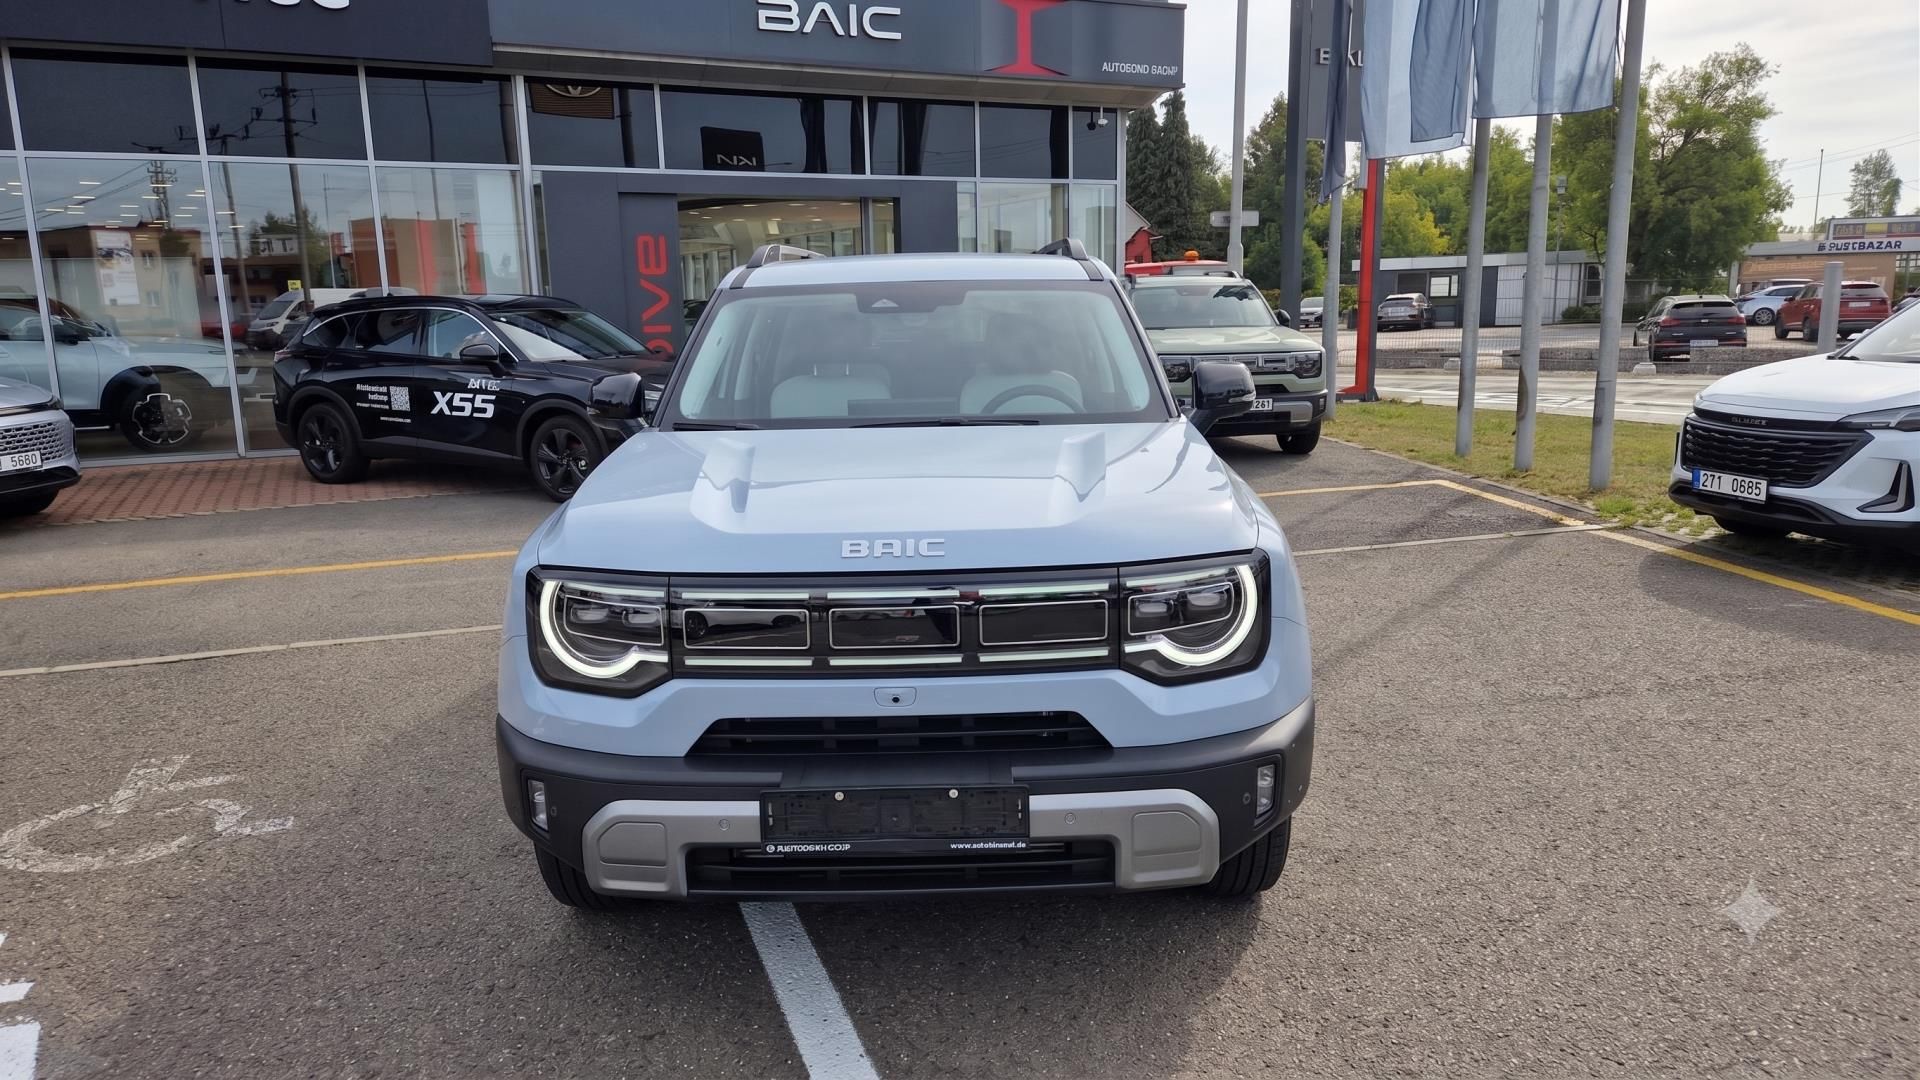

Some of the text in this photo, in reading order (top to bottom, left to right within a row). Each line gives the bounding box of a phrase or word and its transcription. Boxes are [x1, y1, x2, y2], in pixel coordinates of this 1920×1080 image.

[757, 0, 902, 40] BAIC
[430, 391, 497, 418] X55
[1252, 400, 1270, 409] 261
[11, 453, 38, 468] 5680
[1731, 478, 1763, 497] 0685
[841, 538, 945, 558] BAIC
